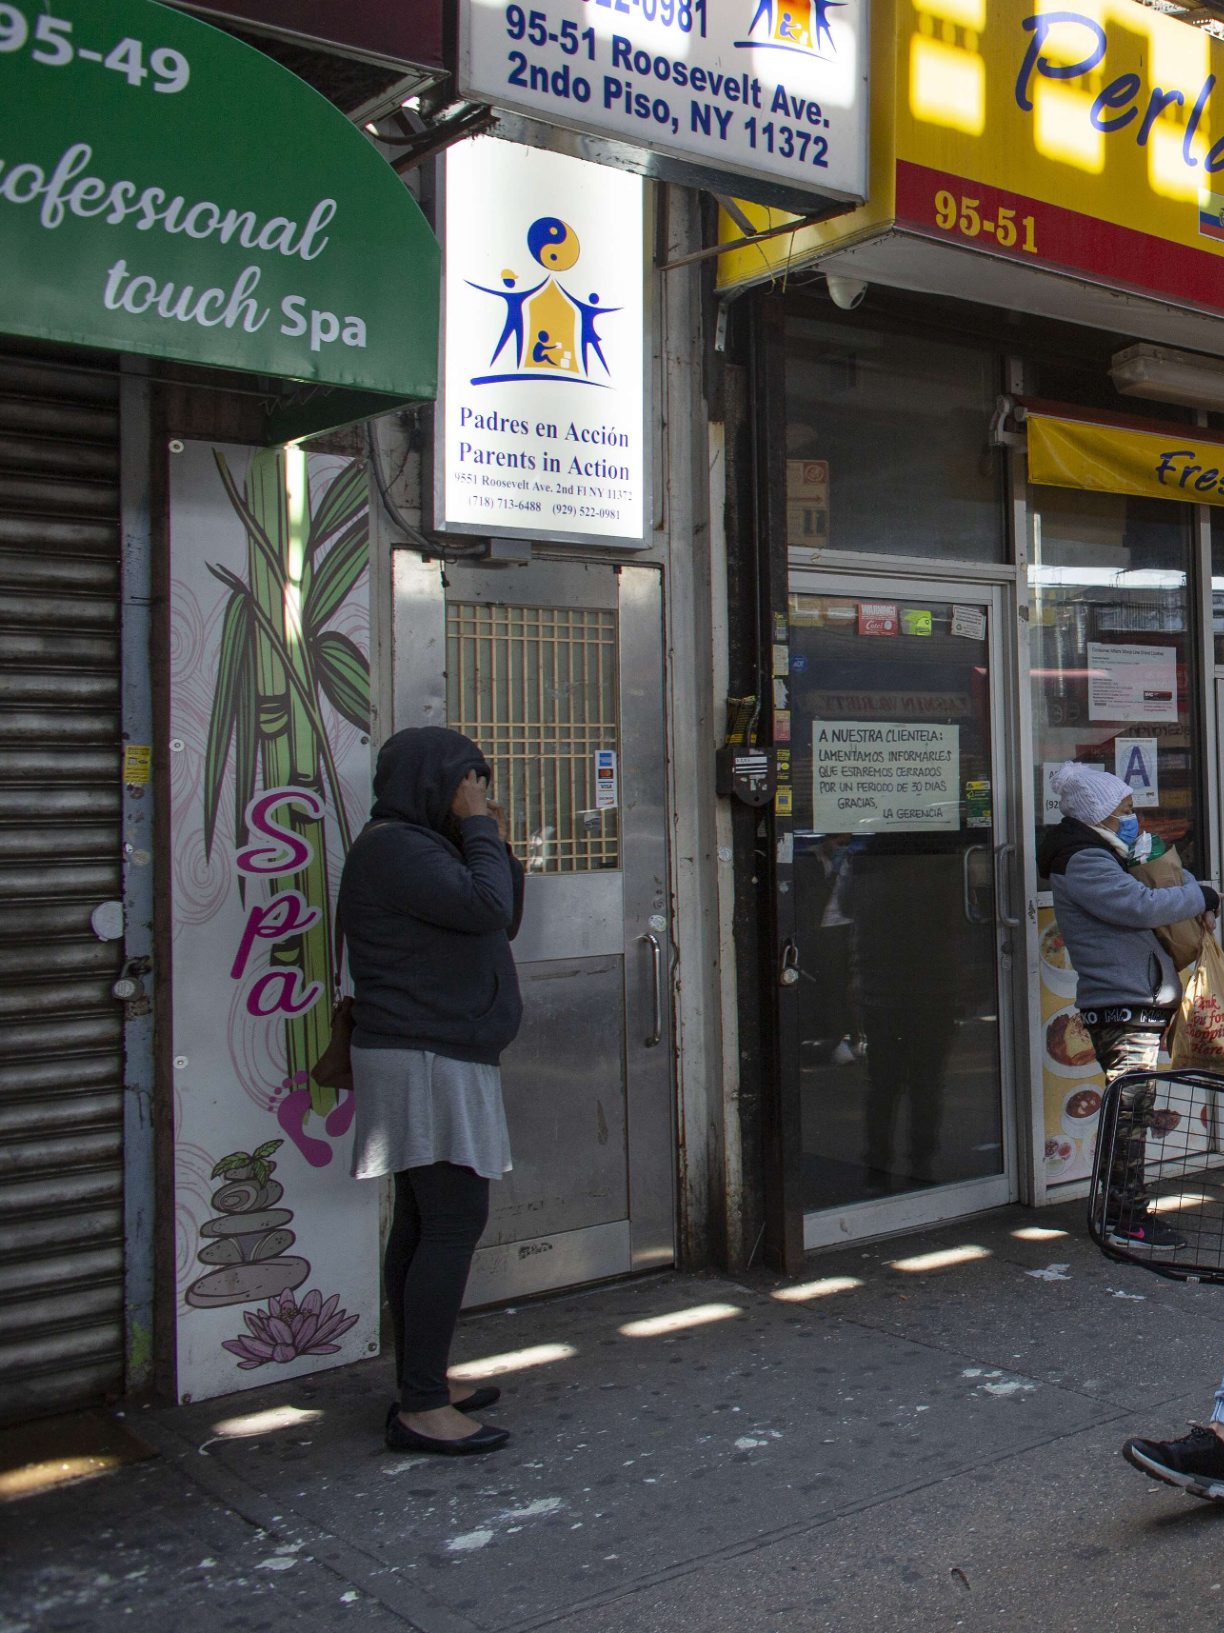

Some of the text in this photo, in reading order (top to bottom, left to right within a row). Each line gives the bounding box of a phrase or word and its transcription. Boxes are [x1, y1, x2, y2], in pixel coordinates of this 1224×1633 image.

[0, 5, 191, 94] 95-49
[506, 4, 831, 128] 95-51 Roosevelt Ave.
[507, 52, 830, 168] 2ndo Piso, NY 11372
[934, 189, 1039, 254] 95-51
[103, 259, 368, 352] touch Spa
[460, 406, 630, 448] Padres en Acción
[459, 441, 630, 481] Parents in Action
[454, 472, 477, 485] 9551
[482, 474, 529, 491] Roosevelt
[532, 481, 553, 493] Ave.
[556, 482, 574, 496] 2nd
[588, 487, 604, 498] NY
[607, 488, 633, 501] 11372
[468, 494, 621, 520] (718) 713-6488 (929) 522-0981
[818, 728, 943, 743] A NUESTRA CLIENTELA:
[819, 749, 952, 763] LAMENTAMOS INFORMARLES
[819, 765, 942, 778] QUE ESTAREMOS CERRADOS
[1124, 745, 1151, 787] A
[819, 781, 947, 794] POR UN PERIODO DE 30 DIAS
[837, 797, 878, 810] GRACIAS,
[882, 808, 943, 819] LA GERENCIA
[230, 790, 321, 1017] Spa
